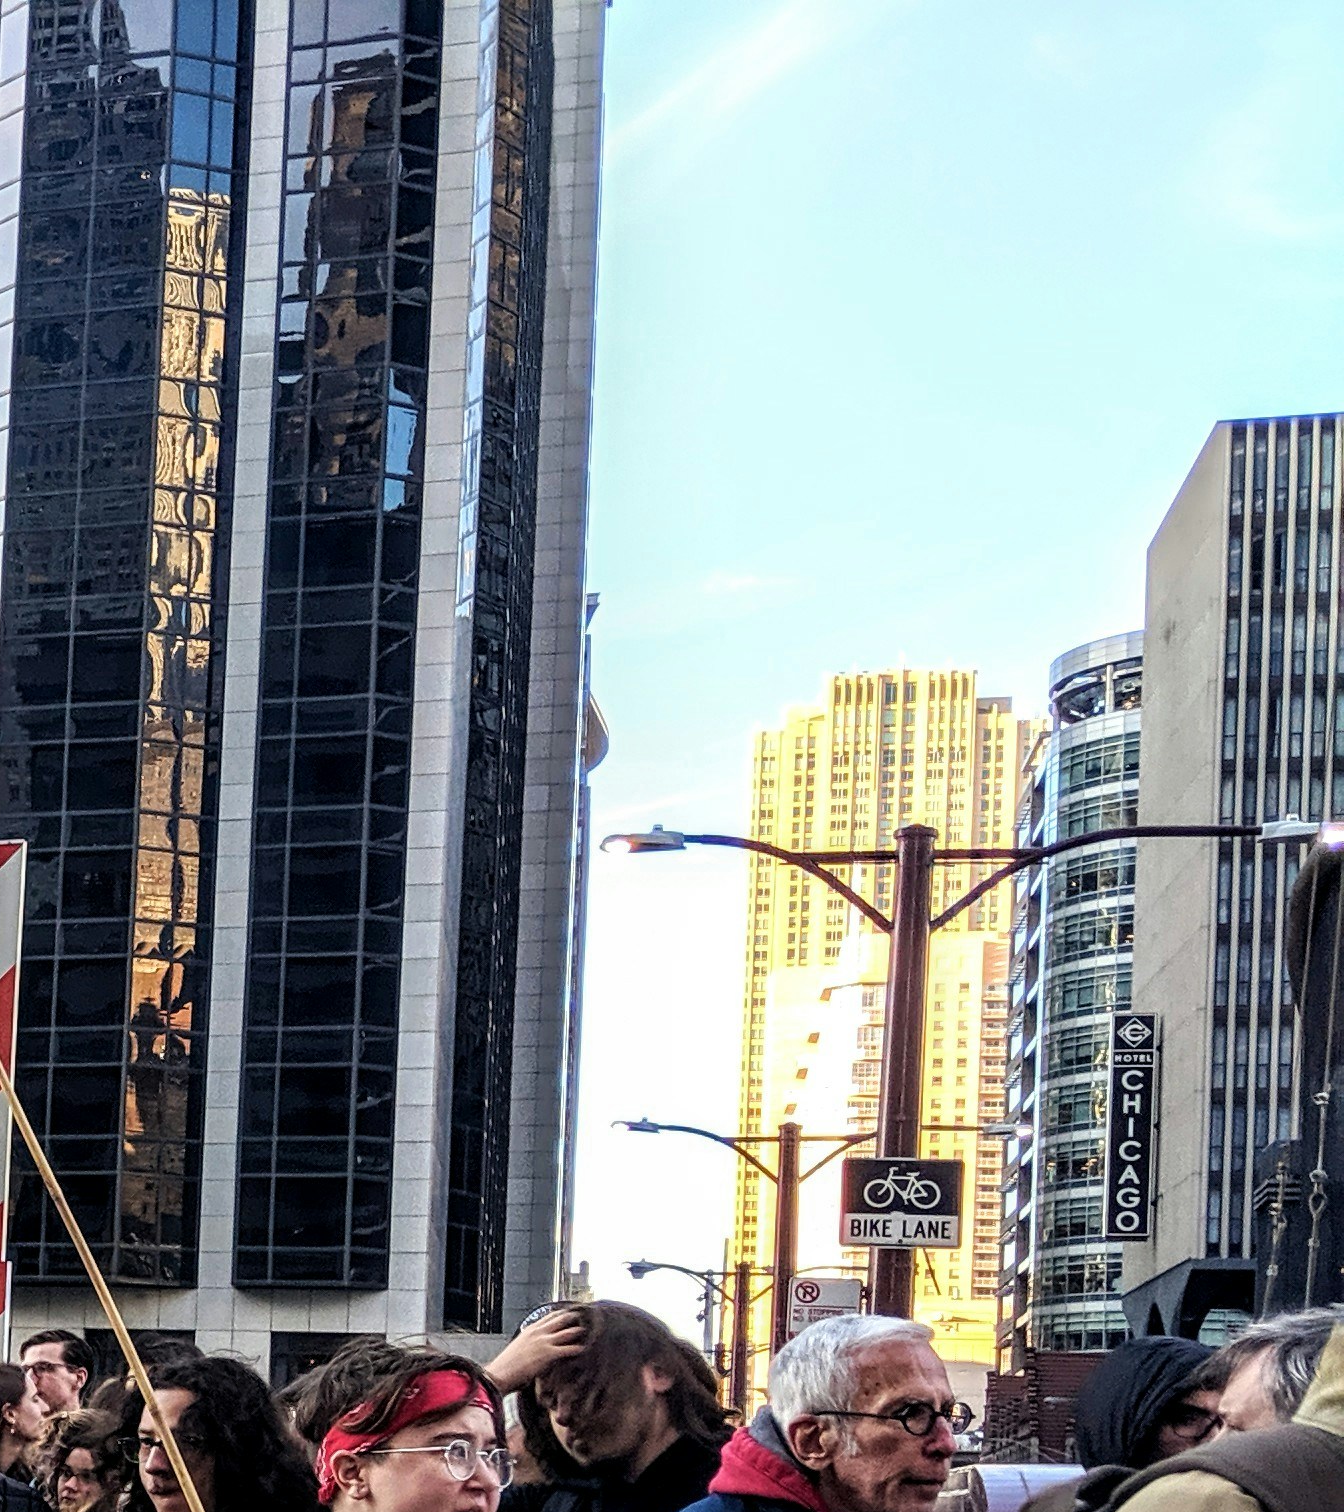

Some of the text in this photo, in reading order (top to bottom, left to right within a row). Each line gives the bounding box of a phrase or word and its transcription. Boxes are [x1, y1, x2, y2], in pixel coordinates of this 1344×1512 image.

[1115, 1054, 1152, 1063] HOTEL
[1115, 1069, 1145, 1232] CHICAGO
[851, 1219, 951, 1239] BIKE LANE
